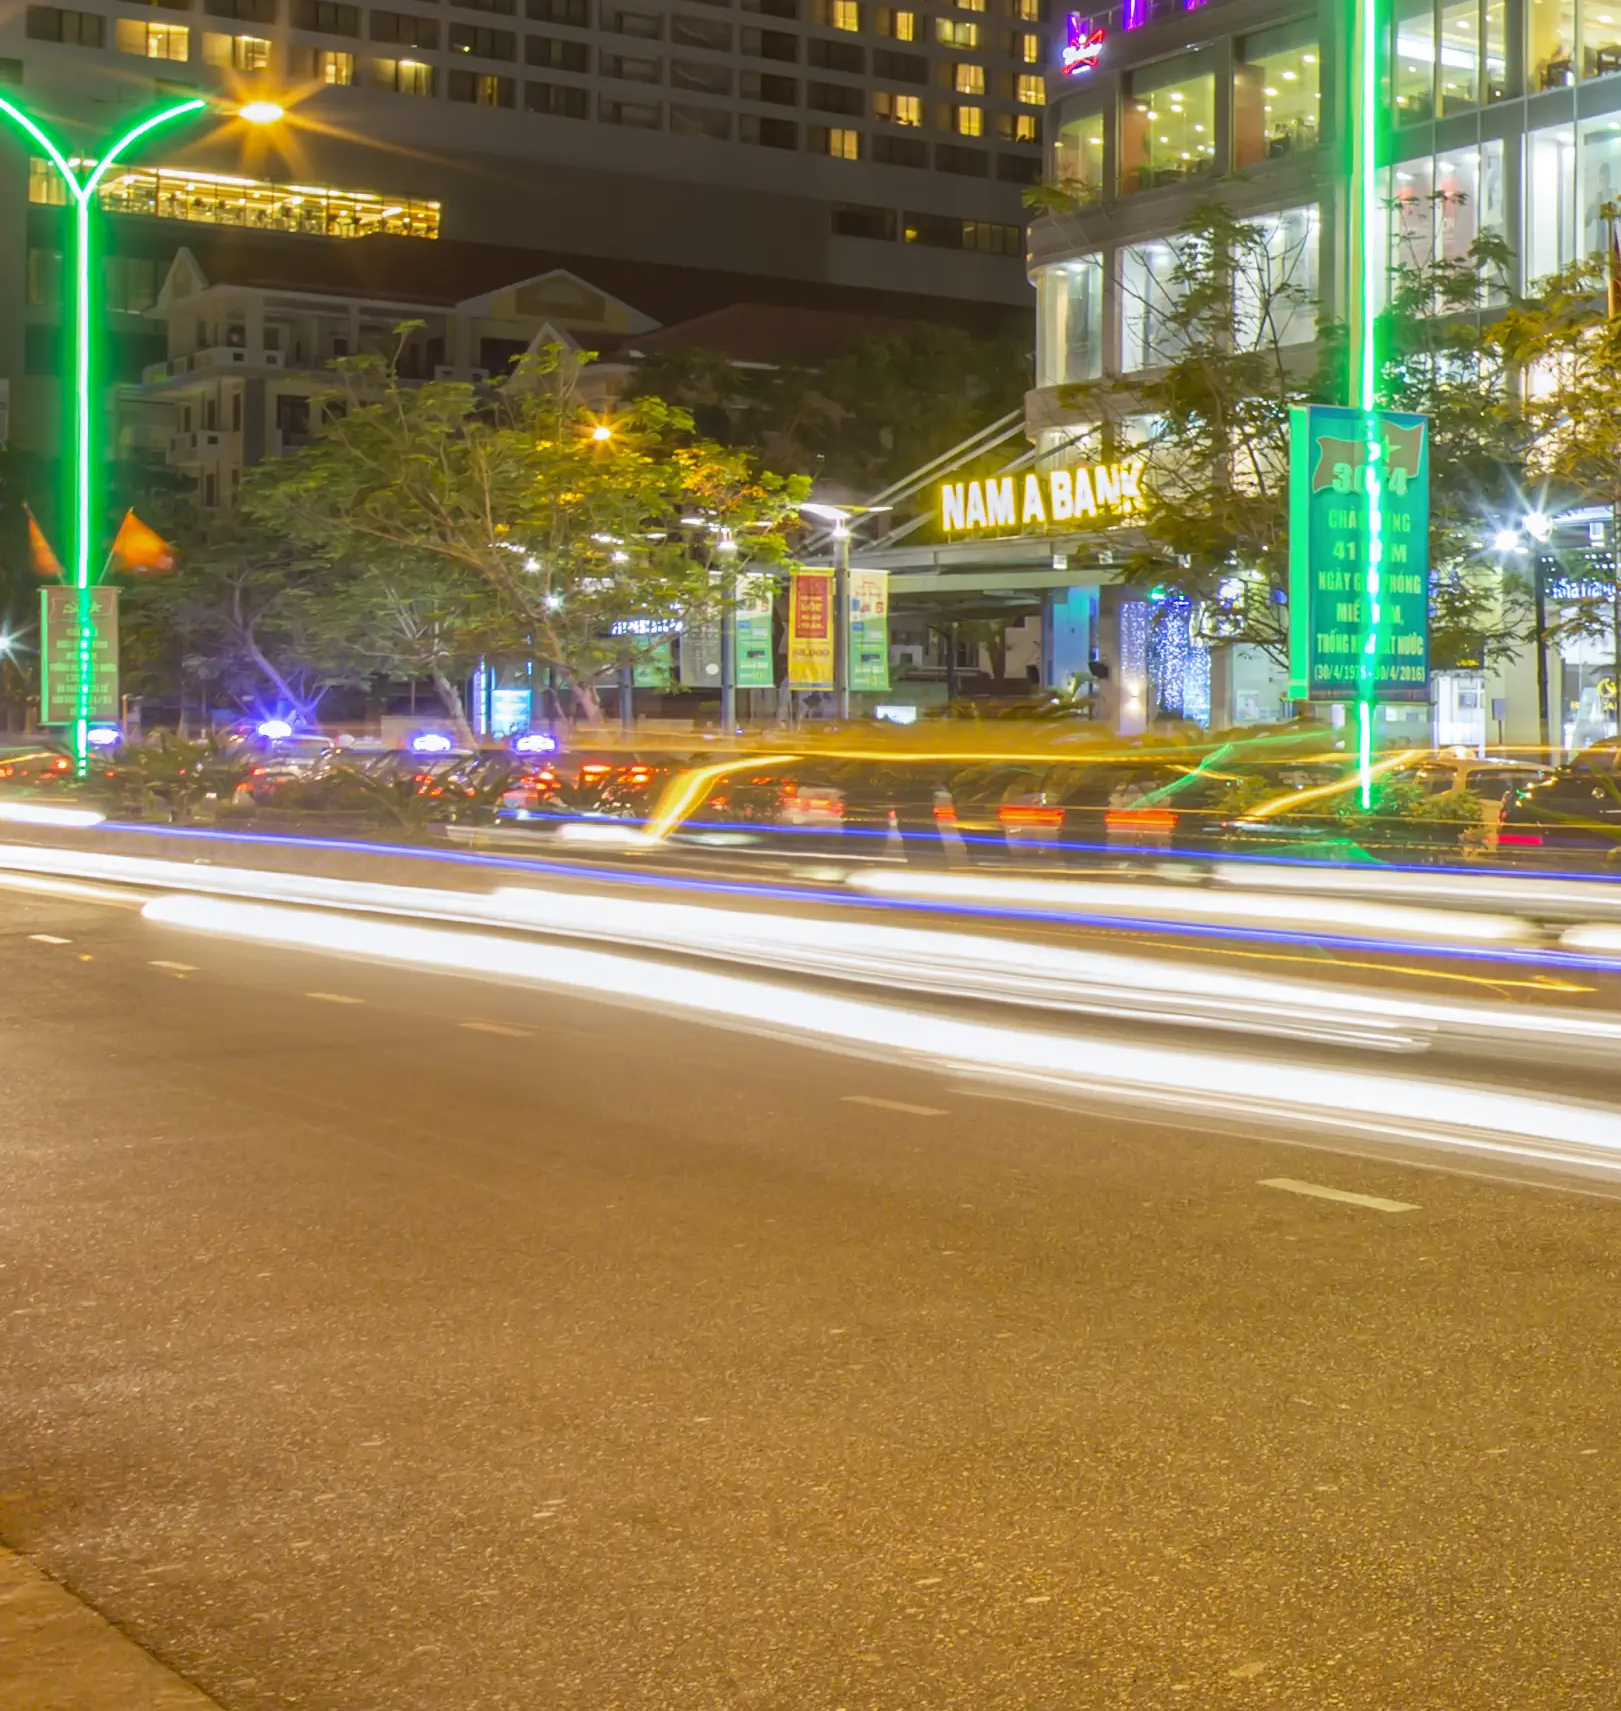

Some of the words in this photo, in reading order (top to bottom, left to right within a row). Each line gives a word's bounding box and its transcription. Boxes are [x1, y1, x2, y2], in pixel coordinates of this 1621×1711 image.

[941, 475, 1016, 532] NAM
[1022, 473, 1046, 524] A
[1049, 457, 1149, 521] BANK
[1331, 540, 1357, 561] 41
[1318, 567, 1352, 591] NGÀY
[1382, 569, 1422, 595] HÓNG
